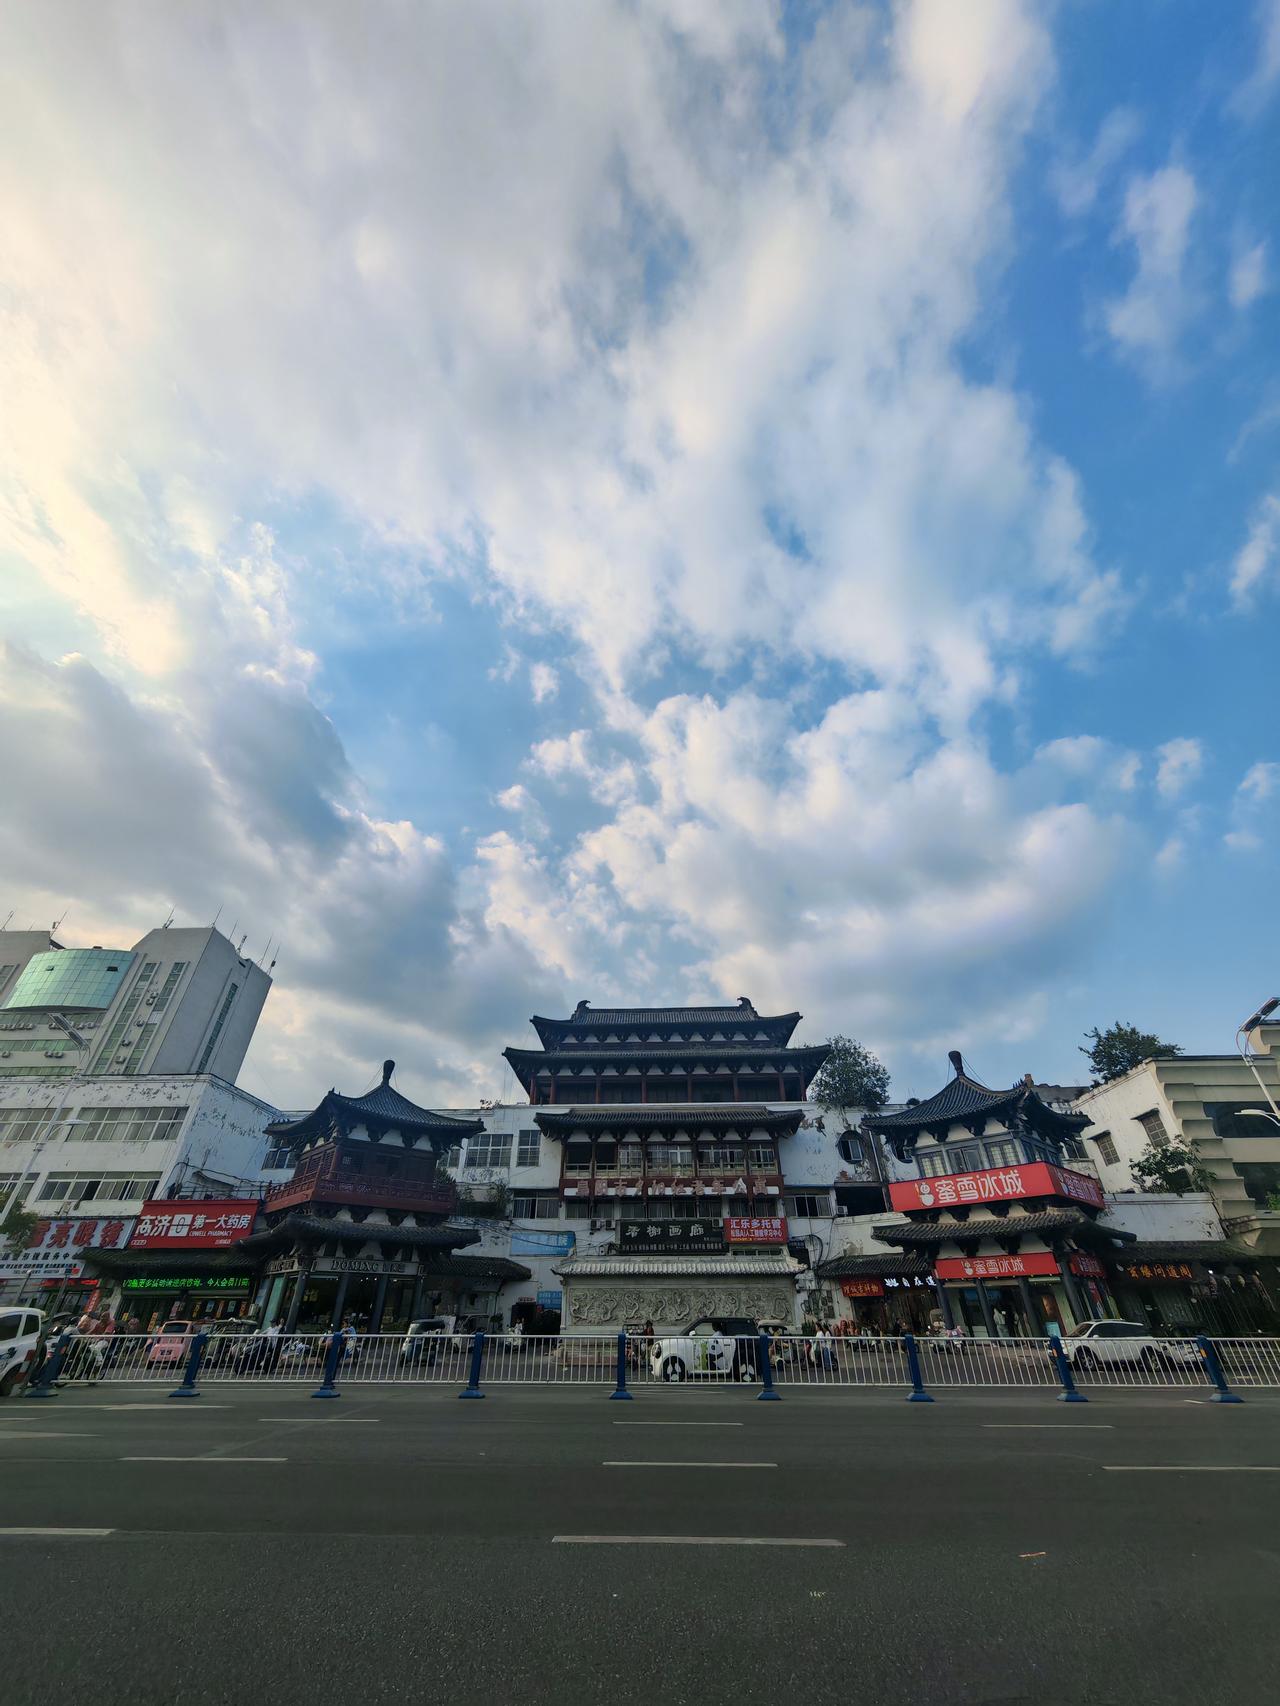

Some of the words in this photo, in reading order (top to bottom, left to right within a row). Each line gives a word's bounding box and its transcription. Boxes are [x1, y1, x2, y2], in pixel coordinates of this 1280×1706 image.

[934, 1169, 1025, 1204] 蜜雪冰城
[134, 1214, 172, 1237] 高济
[191, 1214, 252, 1230] 第一大药房
[730, 1218, 782, 1229] 汇乐多托管
[973, 1257, 1026, 1274] 蜜雪冰城
